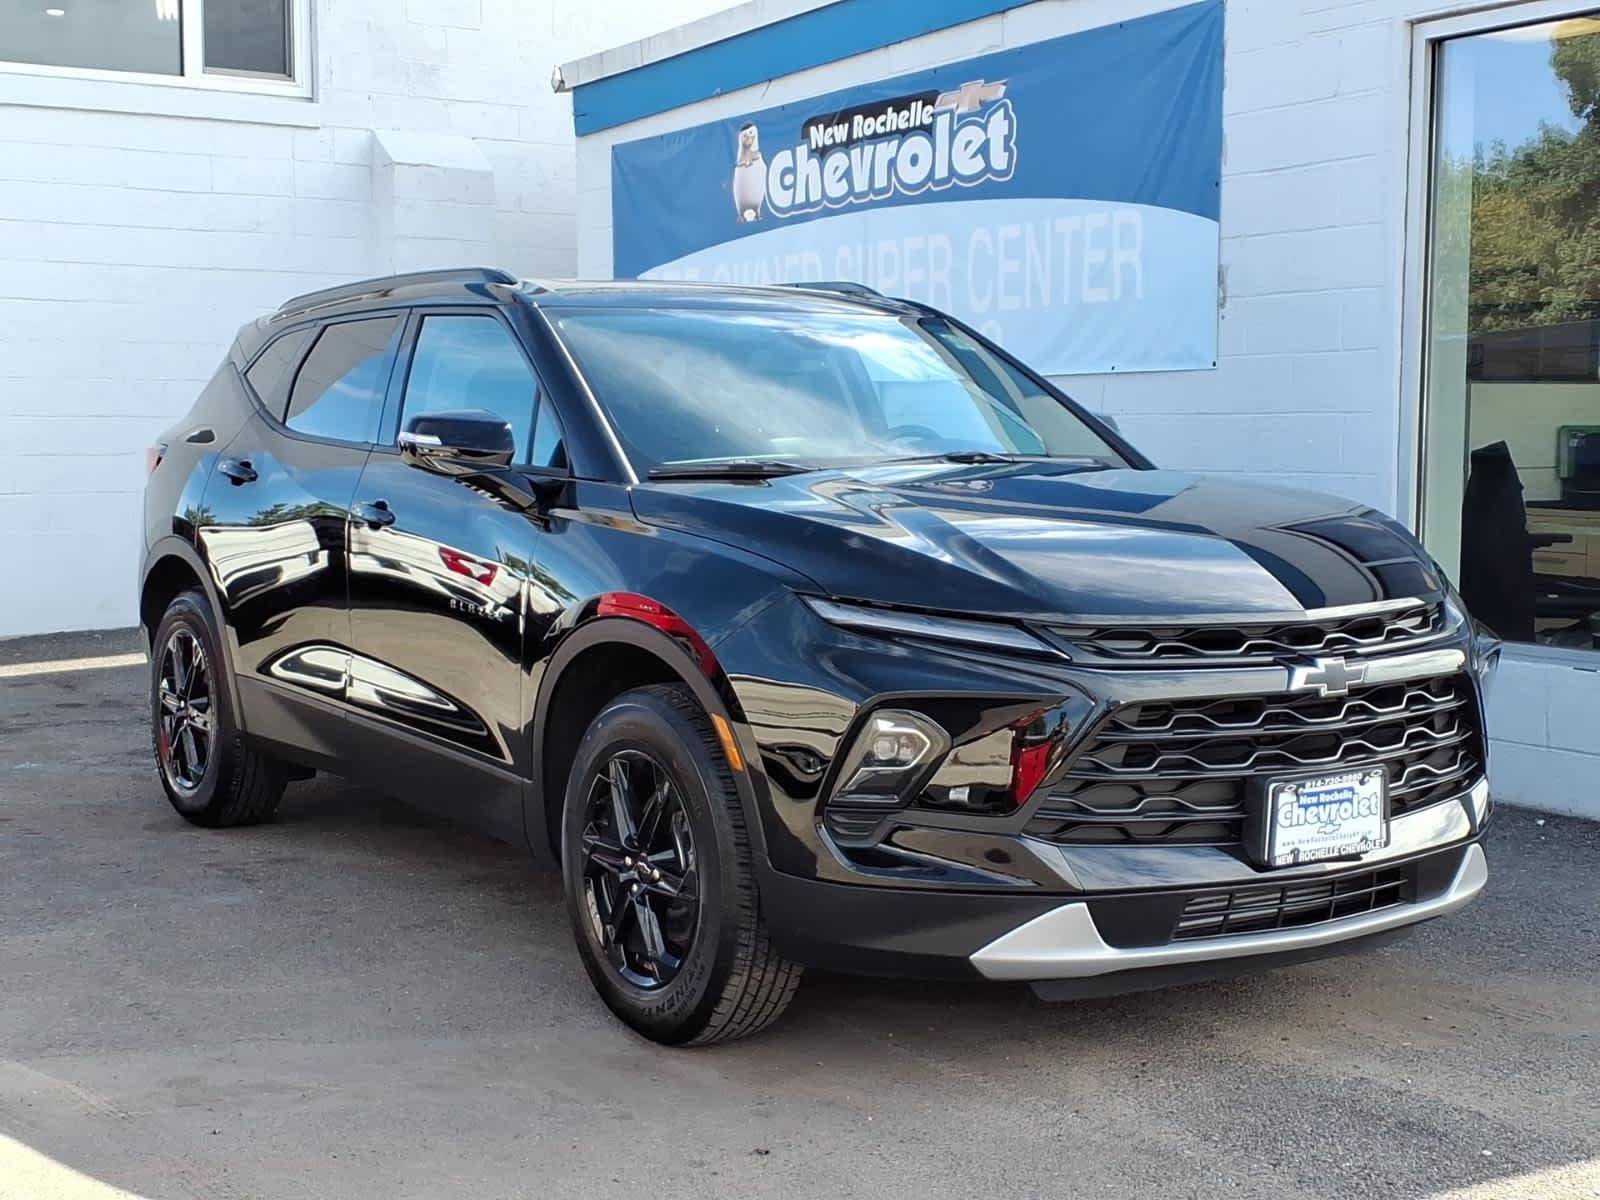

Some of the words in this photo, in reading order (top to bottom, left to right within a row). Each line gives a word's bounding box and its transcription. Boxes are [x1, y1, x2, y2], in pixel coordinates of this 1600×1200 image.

[809, 122, 849, 149] New
[853, 100, 935, 139] Rochelle
[766, 105, 1012, 210] Chevrolet
[967, 209, 1146, 313] CENTER
[1278, 792, 1380, 828] Chevrolet
[1275, 853, 1294, 866] NEW
[1298, 846, 1340, 862] ROCHELLE
[1340, 839, 1386, 856] CHEVROLET
